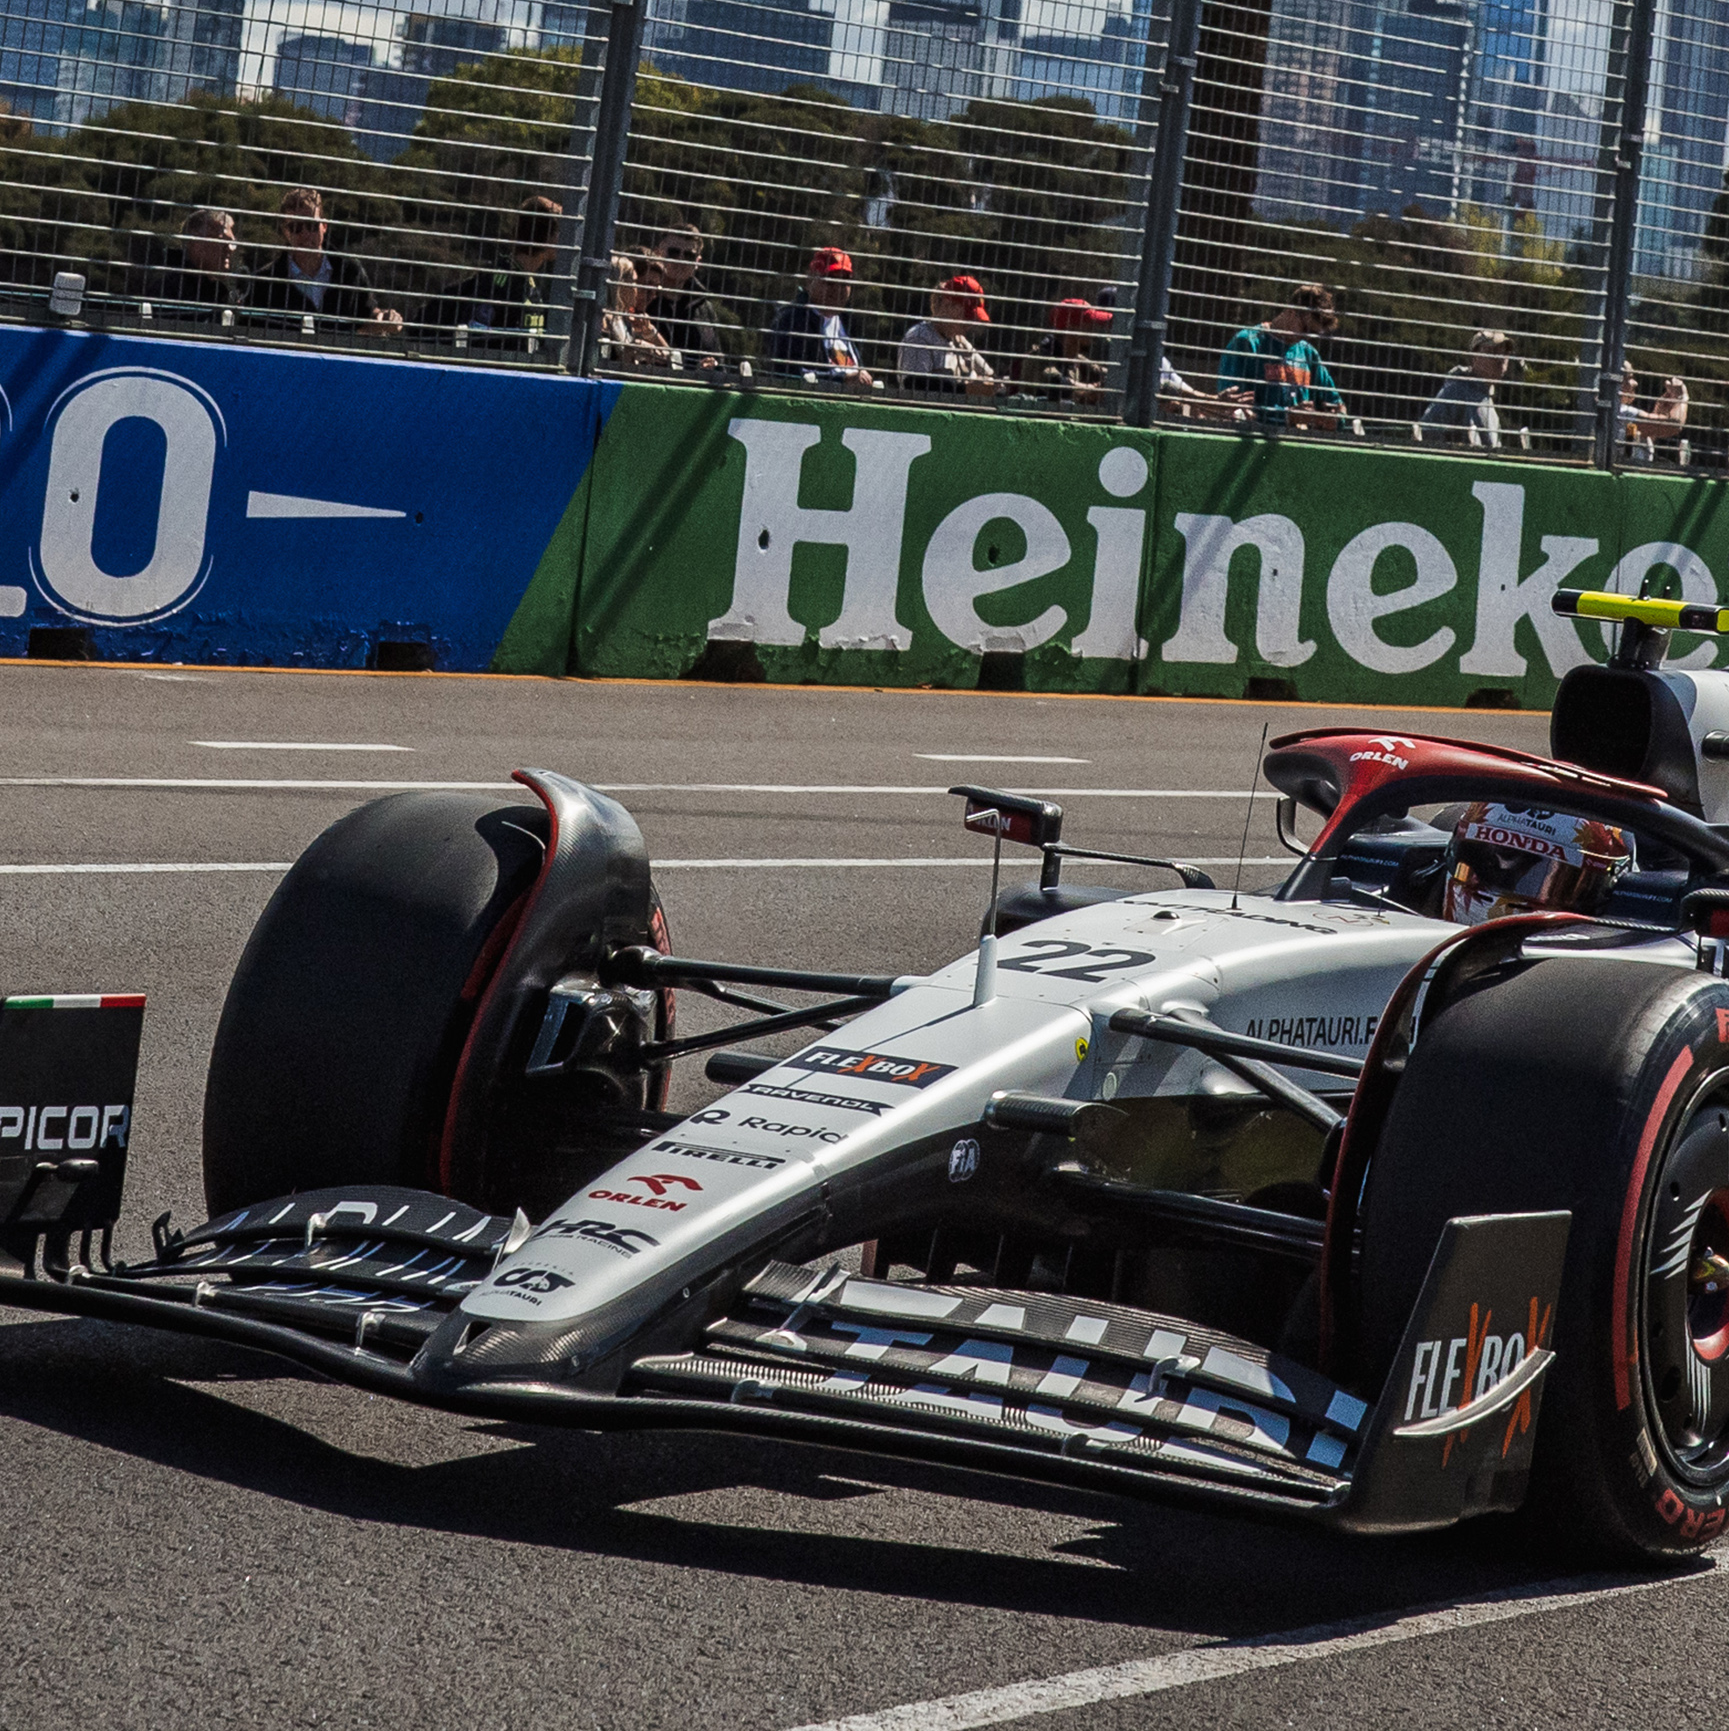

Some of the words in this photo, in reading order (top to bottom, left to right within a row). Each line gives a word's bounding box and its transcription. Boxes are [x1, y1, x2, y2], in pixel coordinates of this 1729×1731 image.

[1349, 750, 1409, 770] ORLEN
[1474, 825, 1568, 862] HONDA
[997, 939, 1156, 984] 22
[752, 1086, 874, 1111] RAVENOL
[651, 1141, 786, 1169] PIRELLI
[588, 1190, 687, 1212] ORLEN
[532, 1219, 661, 1254] HRC
